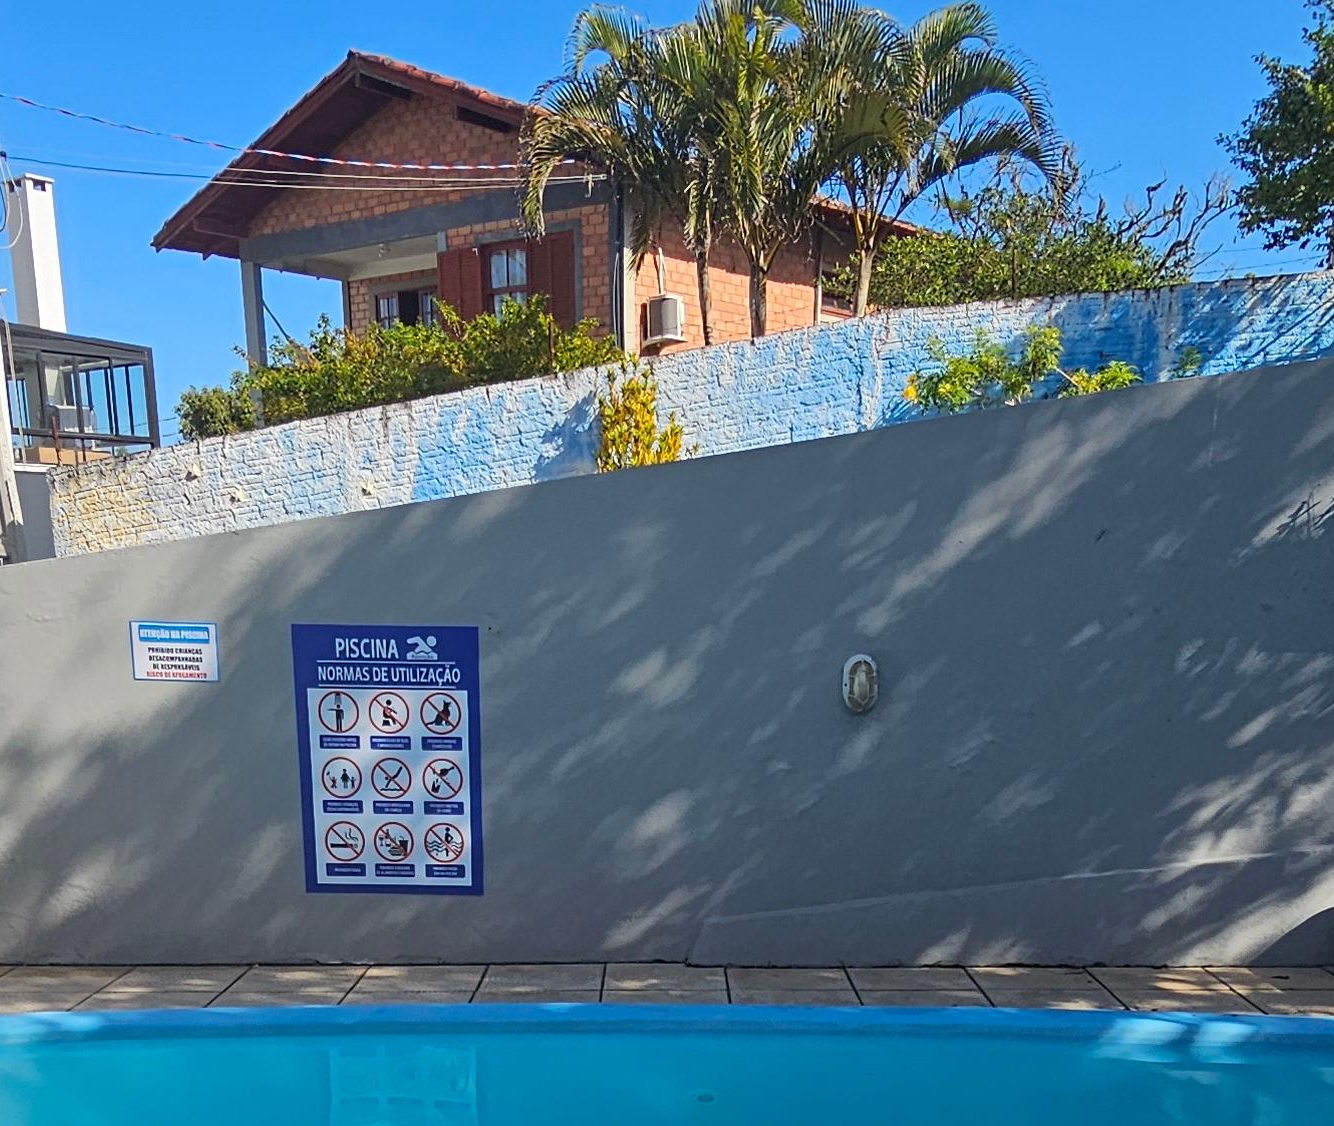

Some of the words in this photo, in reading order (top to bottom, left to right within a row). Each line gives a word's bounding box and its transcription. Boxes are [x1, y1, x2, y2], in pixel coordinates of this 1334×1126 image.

[335, 638, 399, 659] PISCINA
[318, 666, 370, 681] NORMAS
[372, 667, 388, 682] DE
[391, 664, 461, 687] UTILIZAÇÃO
